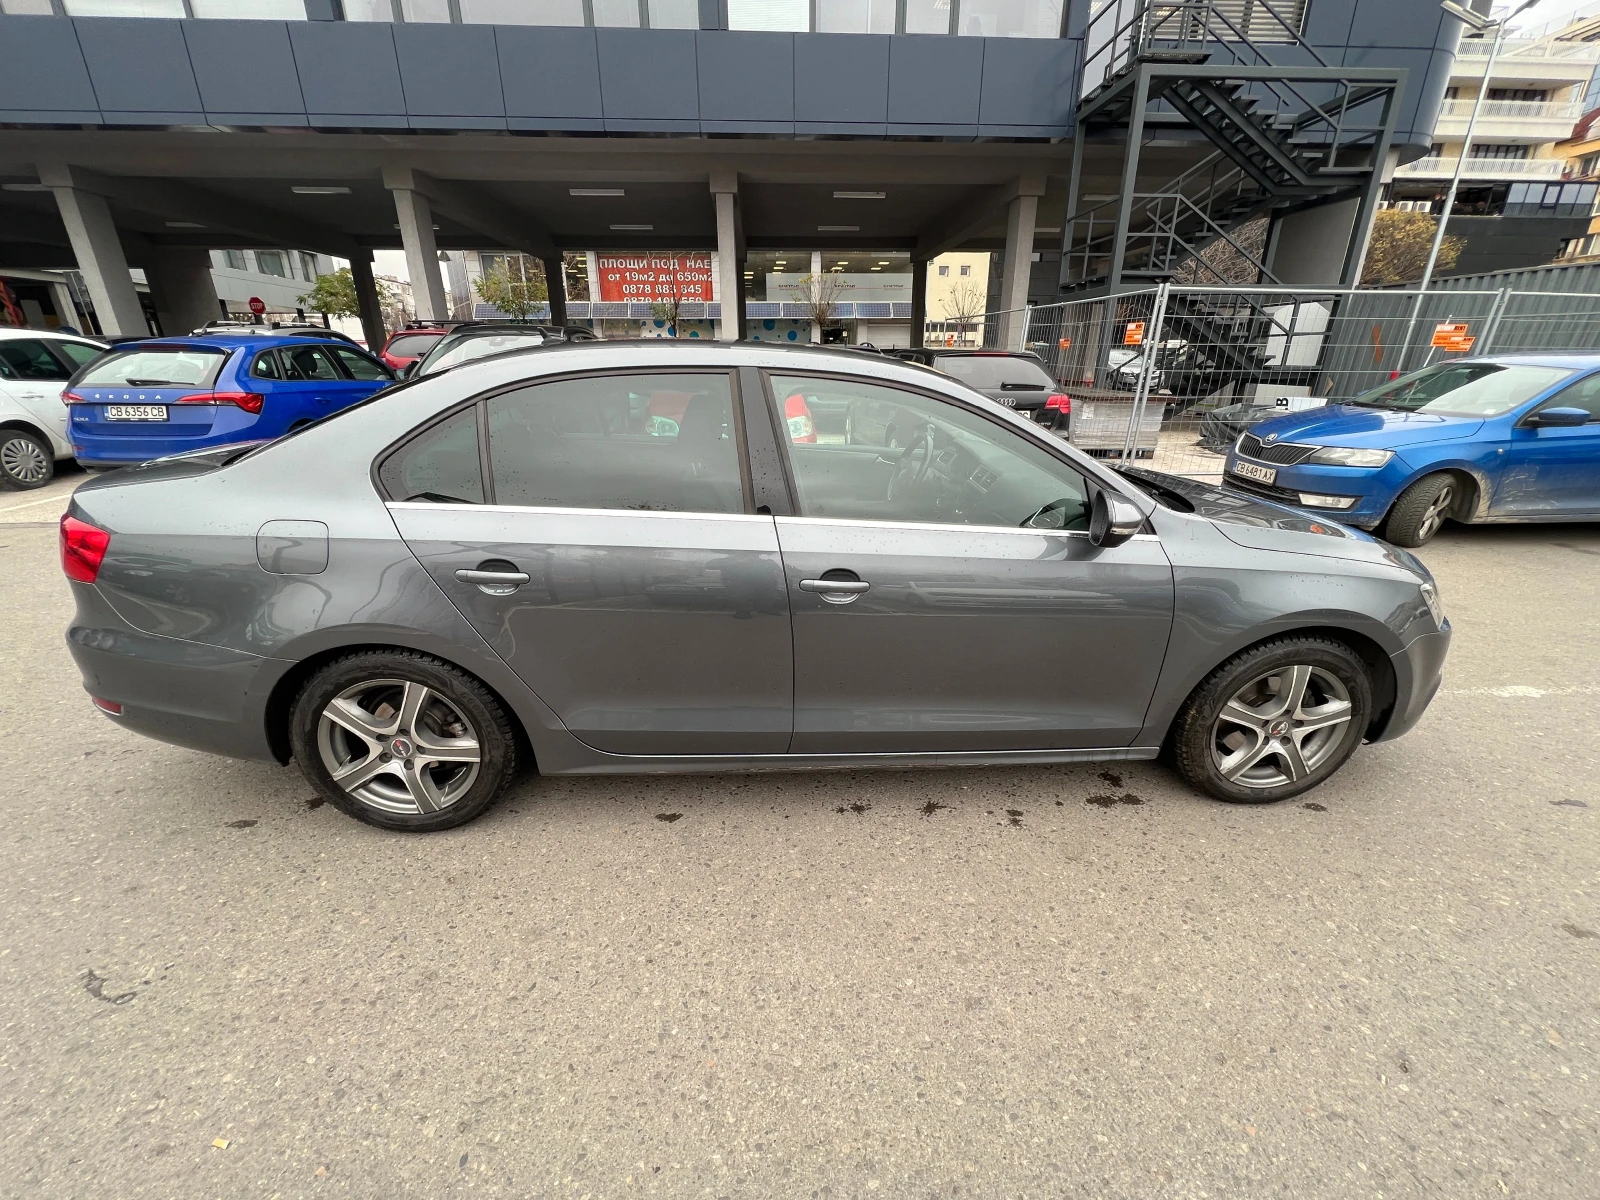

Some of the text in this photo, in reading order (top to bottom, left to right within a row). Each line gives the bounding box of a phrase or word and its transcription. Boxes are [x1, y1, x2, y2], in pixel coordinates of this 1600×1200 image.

[599, 259, 647, 270] ПЛОЩИ
[651, 259, 679, 270] ПОД
[624, 272, 655, 281] 19м2
[659, 274, 673, 283] до
[622, 284, 652, 294] 0878
[250, 302, 263, 310] STOP
[110, 407, 165, 417] CB 6356 CB
[1236, 462, 1274, 481] CB 6481 AX
